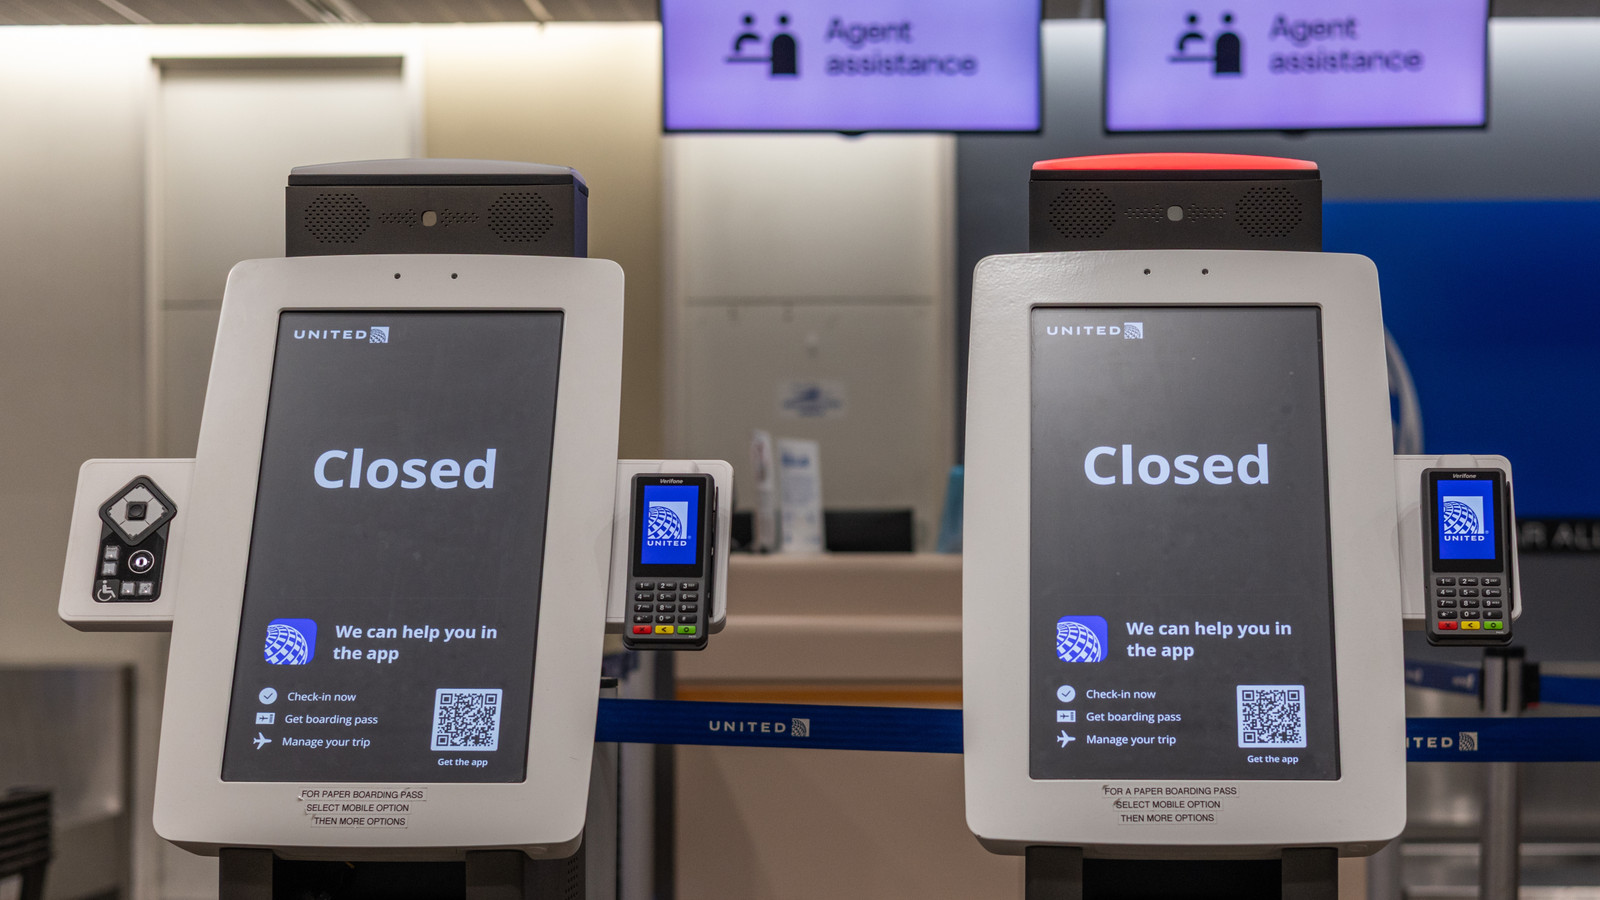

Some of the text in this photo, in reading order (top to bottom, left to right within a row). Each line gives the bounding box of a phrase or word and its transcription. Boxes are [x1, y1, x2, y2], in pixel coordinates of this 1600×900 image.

[825, 16, 912, 46] Agent
[1270, 15, 1358, 45] Agent
[825, 50, 978, 77] assistance
[1269, 47, 1424, 74] assistance
[294, 329, 367, 340] UNITED
[1046, 326, 1121, 336] UNITED
[313, 448, 497, 489] Closed
[1084, 443, 1269, 486] Closed
[336, 625, 497, 642] We can help you in
[1126, 621, 1292, 639] We can help you in
[333, 647, 399, 663] the app
[1126, 644, 1194, 661] the app
[287, 692, 331, 702] Check-in
[1086, 689, 1130, 699] Check-in
[284, 714, 378, 727] Get boarding pass
[1086, 712, 1182, 724] Get boarding pass
[708, 720, 786, 733] UNITED
[282, 737, 371, 749] Manage your trip
[1086, 734, 1176, 746] Manage your trip
[301, 790, 320, 798] FOR
[306, 804, 340, 812] SELECT
[314, 817, 337, 825] THEN
